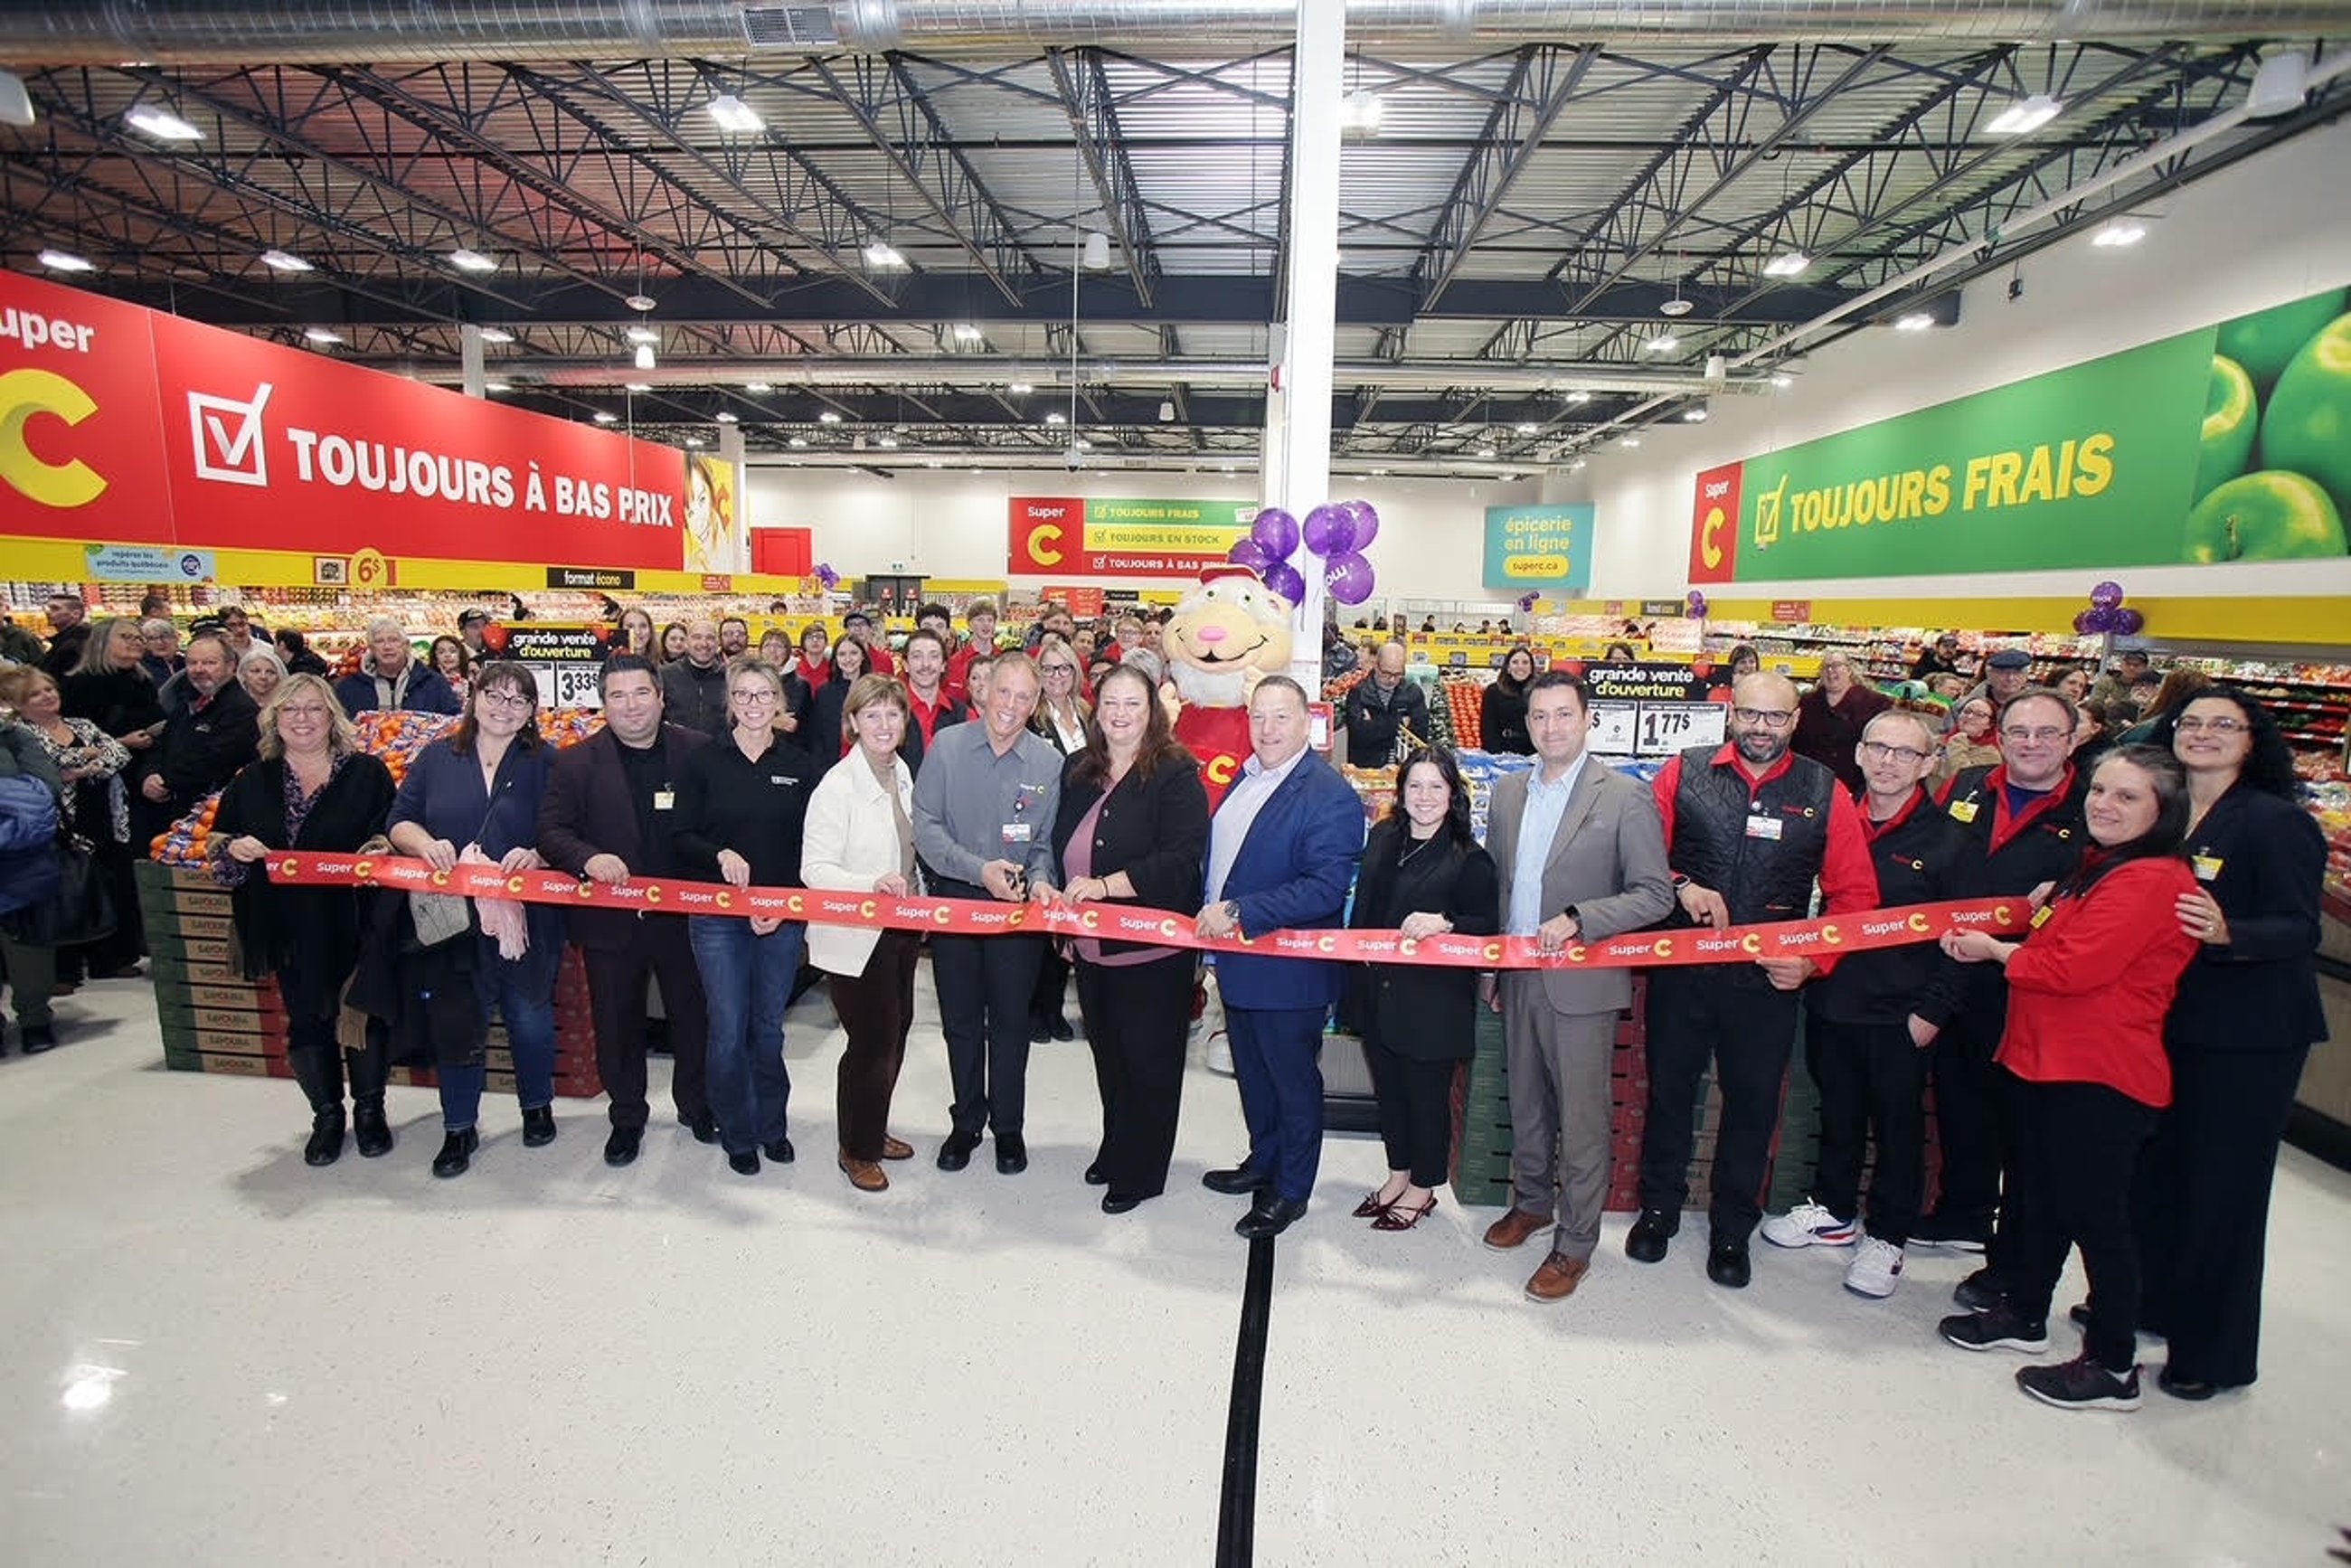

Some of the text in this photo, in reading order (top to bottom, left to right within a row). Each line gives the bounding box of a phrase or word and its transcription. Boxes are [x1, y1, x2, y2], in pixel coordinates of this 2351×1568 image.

[0, 307, 94, 353] uper
[0, 368, 109, 507] C
[288, 427, 674, 527] TOUJOURS À BAS PRIX
[1790, 432, 2115, 533] TOUJOURS FRAIS
[1704, 479, 1729, 498] Super
[1028, 506, 1065, 518] Super
[1110, 507, 1199, 519] TOUJOURS FRAIS
[1505, 515, 1572, 535] épicerie
[1028, 524, 1063, 566] C
[1110, 534, 1220, 543] TOUJOURS EN STOCK
[1505, 534, 1570, 553] en ligne
[1702, 507, 1725, 570] C
[1109, 558, 1164, 569] TOUJOURS
[1166, 555, 1175, 569] À
[1176, 560, 1199, 570] BAS
[1513, 562, 1558, 571] superc.ca
[564, 571, 621, 586] format écono
[514, 631, 597, 647] grande vente
[519, 646, 591, 658] d'ouverture
[1590, 666, 1694, 683] grande vente
[1596, 681, 1685, 697] d'ouverture
[1208, 755, 1235, 784] C
[282, 858, 297, 876] C
[317, 861, 372, 877] Super C
[392, 865, 448, 885] Super C
[469, 874, 524, 893] Super C
[543, 880, 593, 898] Super C
[611, 885, 661, 902] Super C
[679, 891, 732, 908] Super C
[750, 895, 803, 912] Super C
[822, 900, 876, 918] Super C
[895, 905, 950, 924] Super C
[970, 911, 1024, 925] Super C
[1043, 910, 1099, 929] Super C
[1950, 910, 1993, 923] Super
[1994, 906, 2012, 926] C
[1119, 915, 1177, 938] Super C
[1862, 912, 1930, 936] Super C
[1276, 935, 1336, 952] Super C
[1696, 933, 1761, 953] Super C
[1779, 924, 1841, 945] Super C
[1357, 939, 1418, 956] Super C
[1439, 943, 1500, 960] Super C
[1525, 946, 1586, 962] Super C
[1610, 939, 1672, 958] Super C
